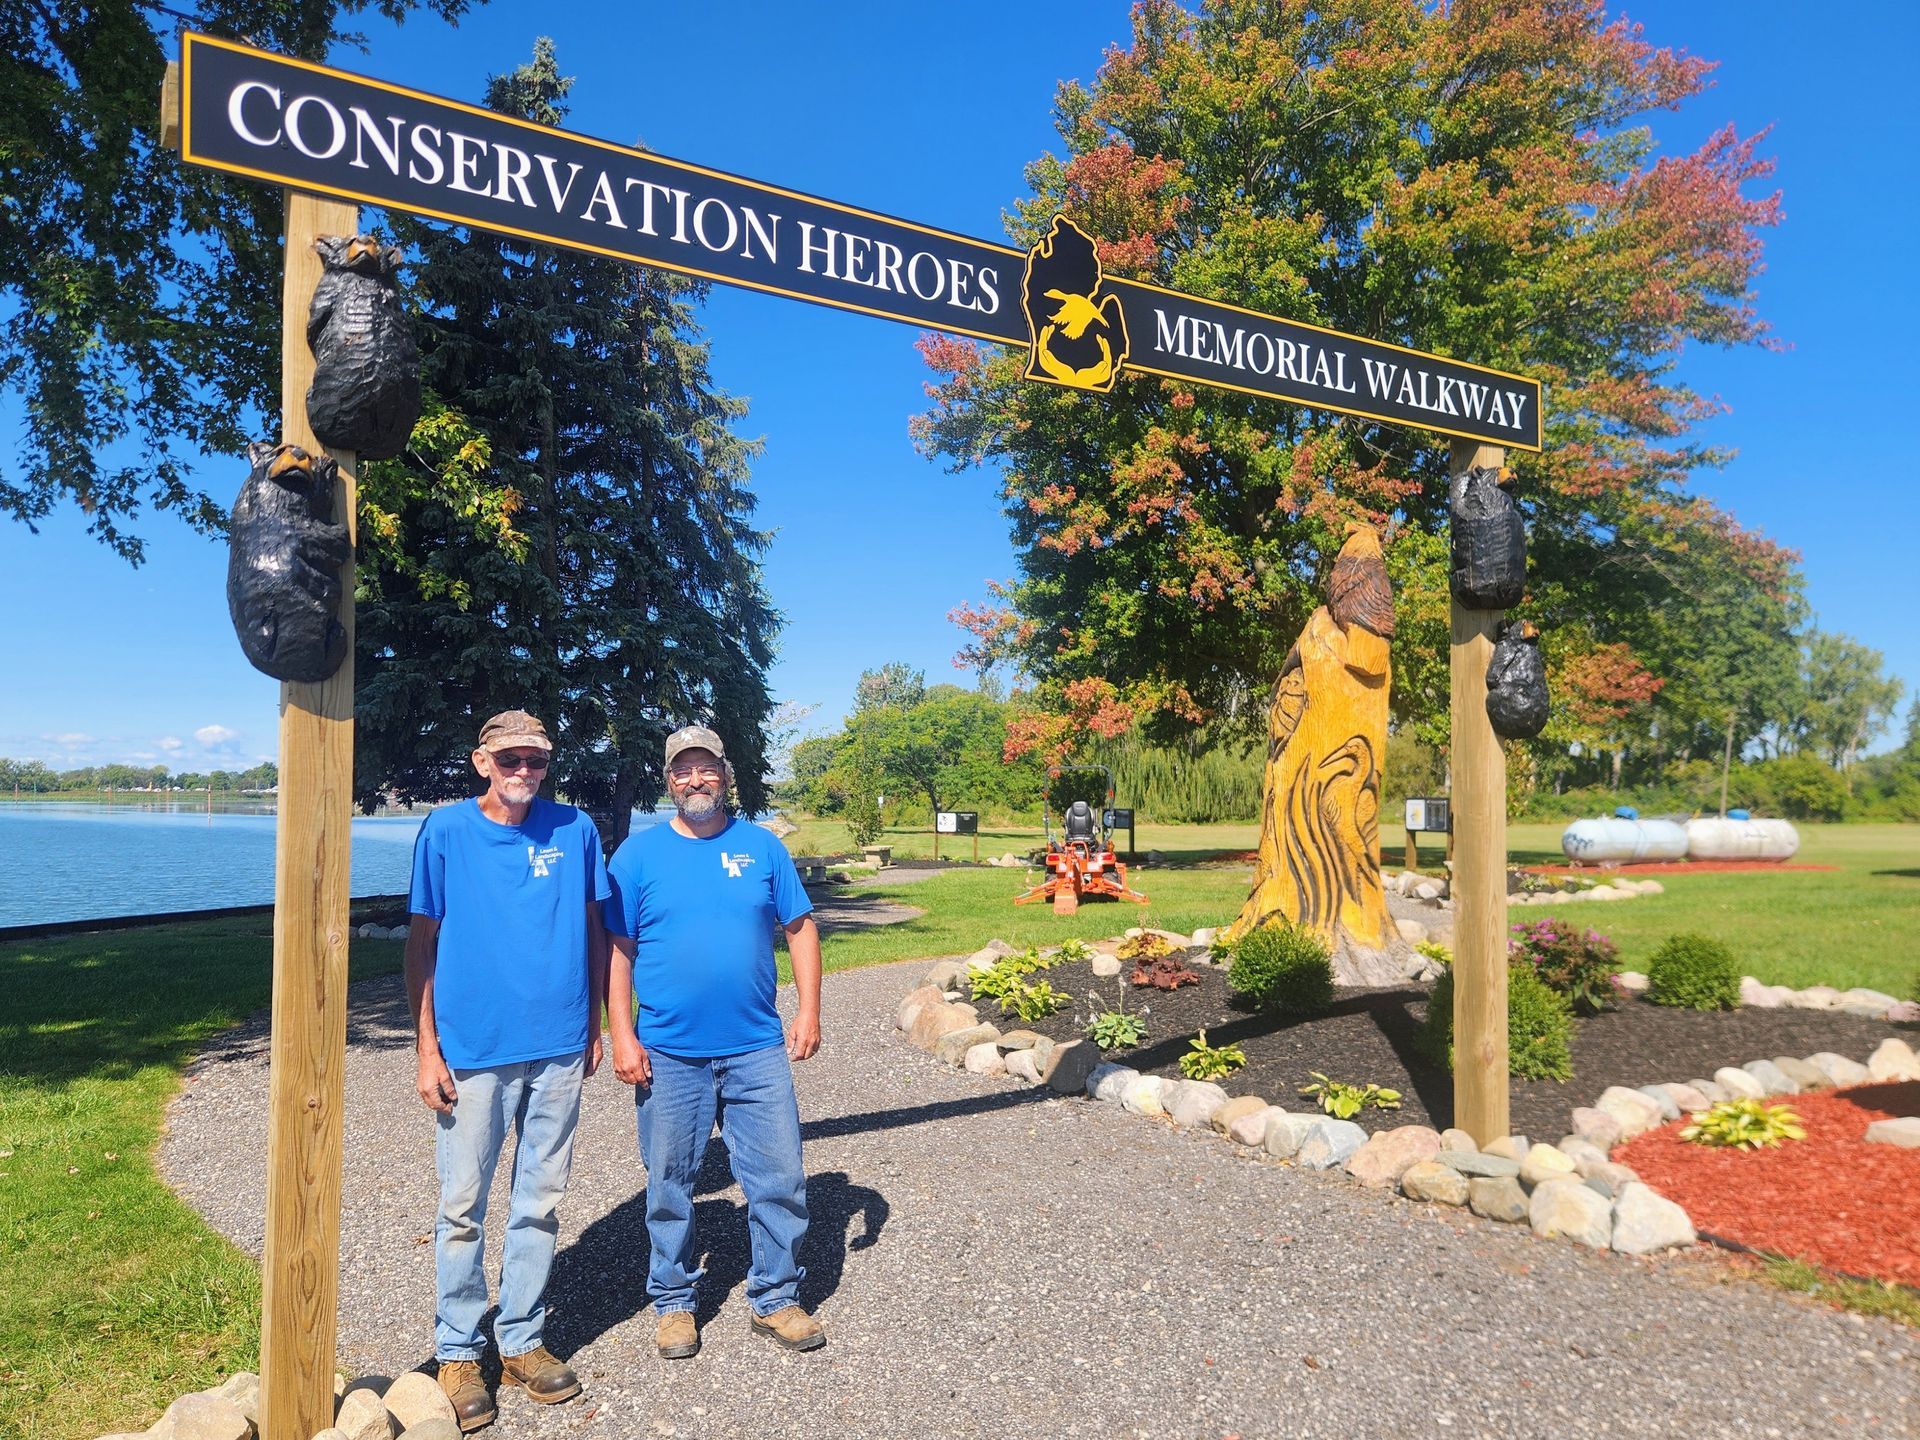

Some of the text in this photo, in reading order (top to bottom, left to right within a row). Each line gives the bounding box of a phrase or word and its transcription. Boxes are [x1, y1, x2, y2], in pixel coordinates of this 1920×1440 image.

[228, 81, 1527, 430] CONSERVATION HEROES MEMORIAL WALKWAY
[535, 851, 564, 860] Landscaping
